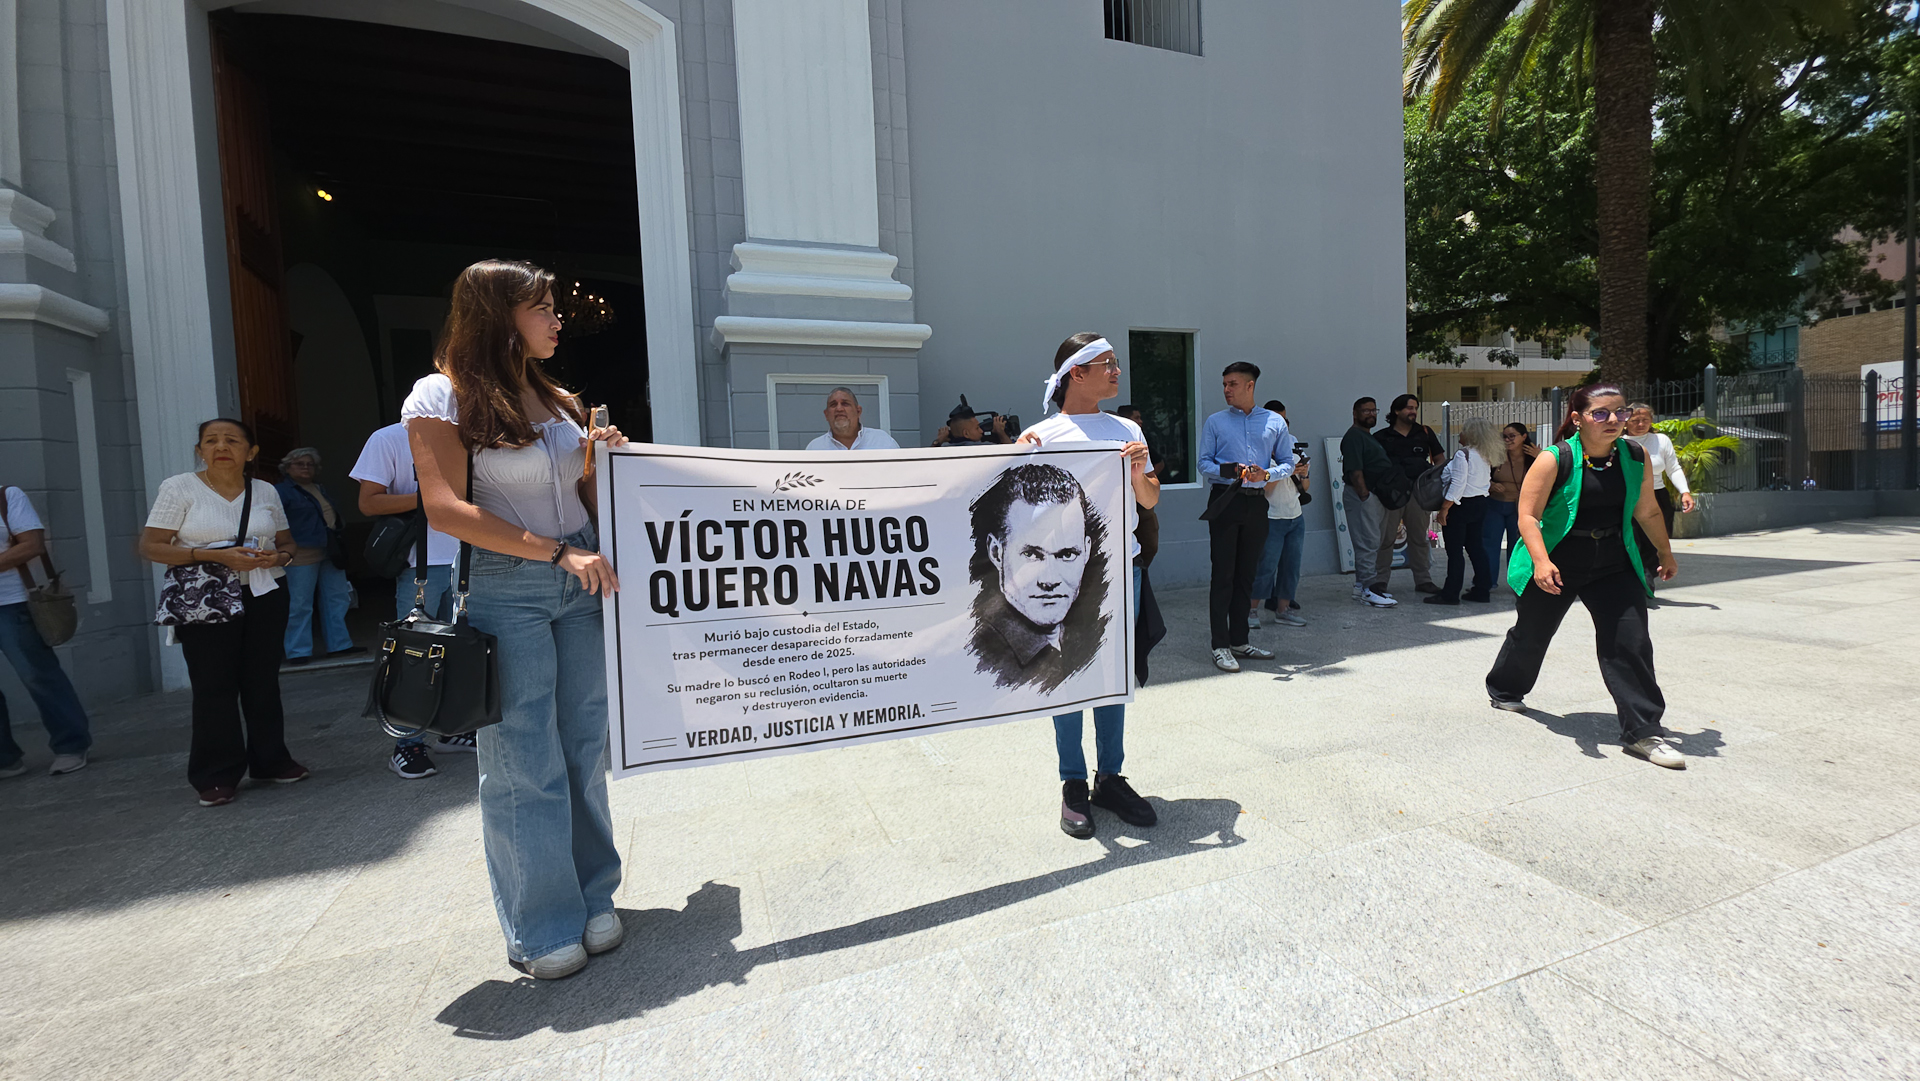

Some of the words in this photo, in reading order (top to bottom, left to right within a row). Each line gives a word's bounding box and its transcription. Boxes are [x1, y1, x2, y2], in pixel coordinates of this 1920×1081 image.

[732, 499, 755, 512] EN
[760, 499, 841, 512] MEMORIA
[846, 499, 866, 511] DE
[645, 510, 810, 564] VÍCTOR
[822, 515, 929, 557] HUGO
[650, 564, 799, 617] QUERO
[813, 557, 941, 603] NAVAS
[673, 651, 696, 661] tras
[699, 644, 768, 659] permanecer
[771, 636, 842, 652] desaparecido
[844, 630, 913, 644] forzadamente
[704, 630, 741, 643] Murió
[744, 628, 770, 640] bajo
[773, 624, 821, 637] custodia
[824, 621, 840, 632] del
[842, 619, 879, 631] Estado,
[742, 655, 776, 668] desde
[778, 653, 808, 664] enero
[811, 650, 824, 660] de
[826, 648, 855, 659] 2025.
[667, 683, 682, 694] Su
[684, 679, 721, 691] madre
[724, 678, 735, 688] lo
[737, 673, 771, 687] buscó
[772, 673, 786, 682] en
[788, 668, 821, 681] Rodeo
[823, 667, 829, 678] I,
[831, 666, 854, 678] pero
[856, 662, 870, 672] las
[872, 656, 926, 670] autoridades
[695, 692, 741, 706] negaron
[744, 691, 756, 699] su
[759, 683, 811, 698] reclusión,
[813, 678, 859, 691] ocultaron
[861, 676, 872, 685] su
[874, 671, 908, 683] muerte
[742, 705, 749, 715] y
[752, 696, 817, 711] destruyeron
[819, 689, 868, 703] evidencia.
[685, 726, 758, 749] VERDAD,
[762, 714, 835, 739] JUSTICIA
[839, 712, 849, 729] Y
[853, 703, 925, 727] MEMORIA.
